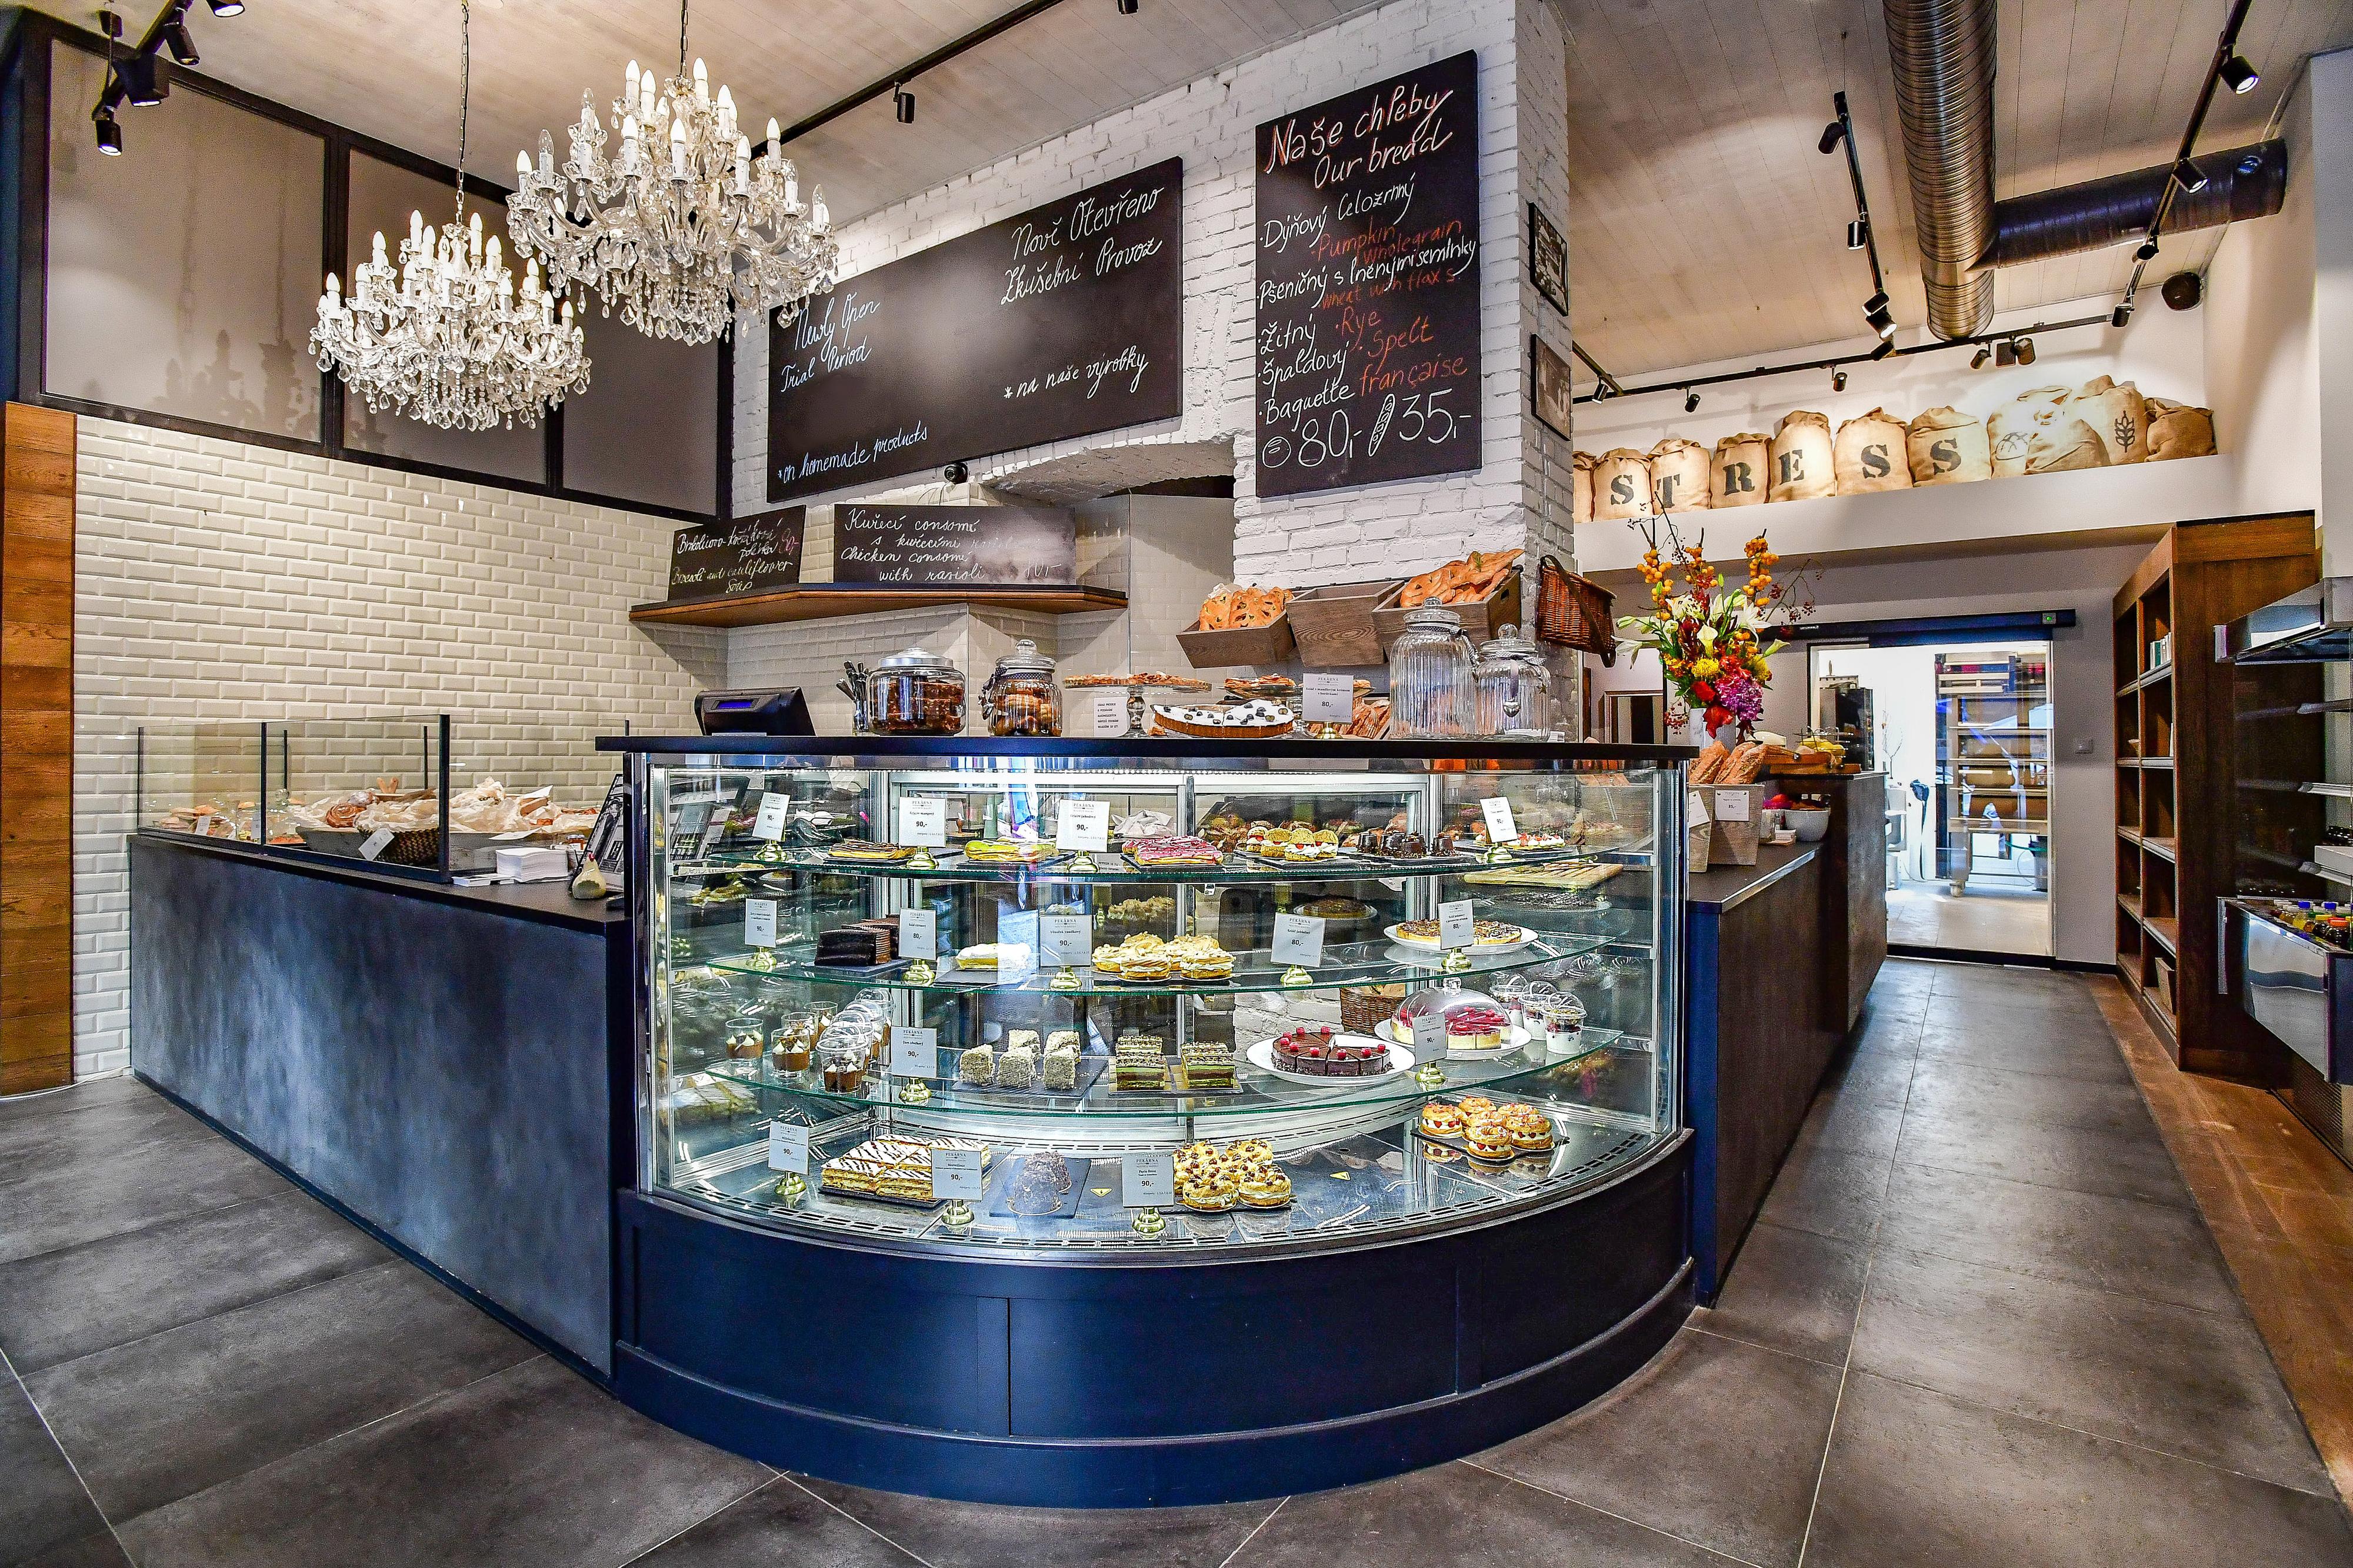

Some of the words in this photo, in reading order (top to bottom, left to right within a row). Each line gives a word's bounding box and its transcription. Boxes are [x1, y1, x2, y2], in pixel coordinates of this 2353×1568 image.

[1264, 116, 1344, 174] Naše
[1355, 84, 1454, 145] chleby
[1314, 155, 1362, 189] Our
[1368, 118, 1453, 173] bread
[1070, 187, 1165, 241] Otevřeno
[1318, 215, 1395, 265] Pumpkin
[1001, 252, 1084, 305] Zkušební
[1095, 236, 1163, 276] Provoz
[1334, 270, 1344, 286] s
[792, 297, 835, 362] Newly
[841, 292, 881, 348] Open
[1341, 306, 1383, 353] Rye
[1368, 315, 1435, 374] Spelt
[781, 356, 816, 392] Trial
[827, 335, 872, 373] Period
[1016, 378, 1040, 398] na
[1045, 364, 1079, 389] naše
[1085, 345, 1149, 399] výrobky
[1266, 375, 1356, 432] Baguette
[1359, 353, 1469, 396] française
[799, 441, 871, 479] homemade
[873, 420, 928, 462] products
[1298, 409, 1363, 467] 80,-
[1399, 388, 1472, 445] 35,-
[1609, 438, 1962, 509] STRESS
[841, 547, 902, 562] Chicken
[871, 532, 882, 546] s
[879, 568, 913, 582] with
[925, 563, 986, 582] ravioli
